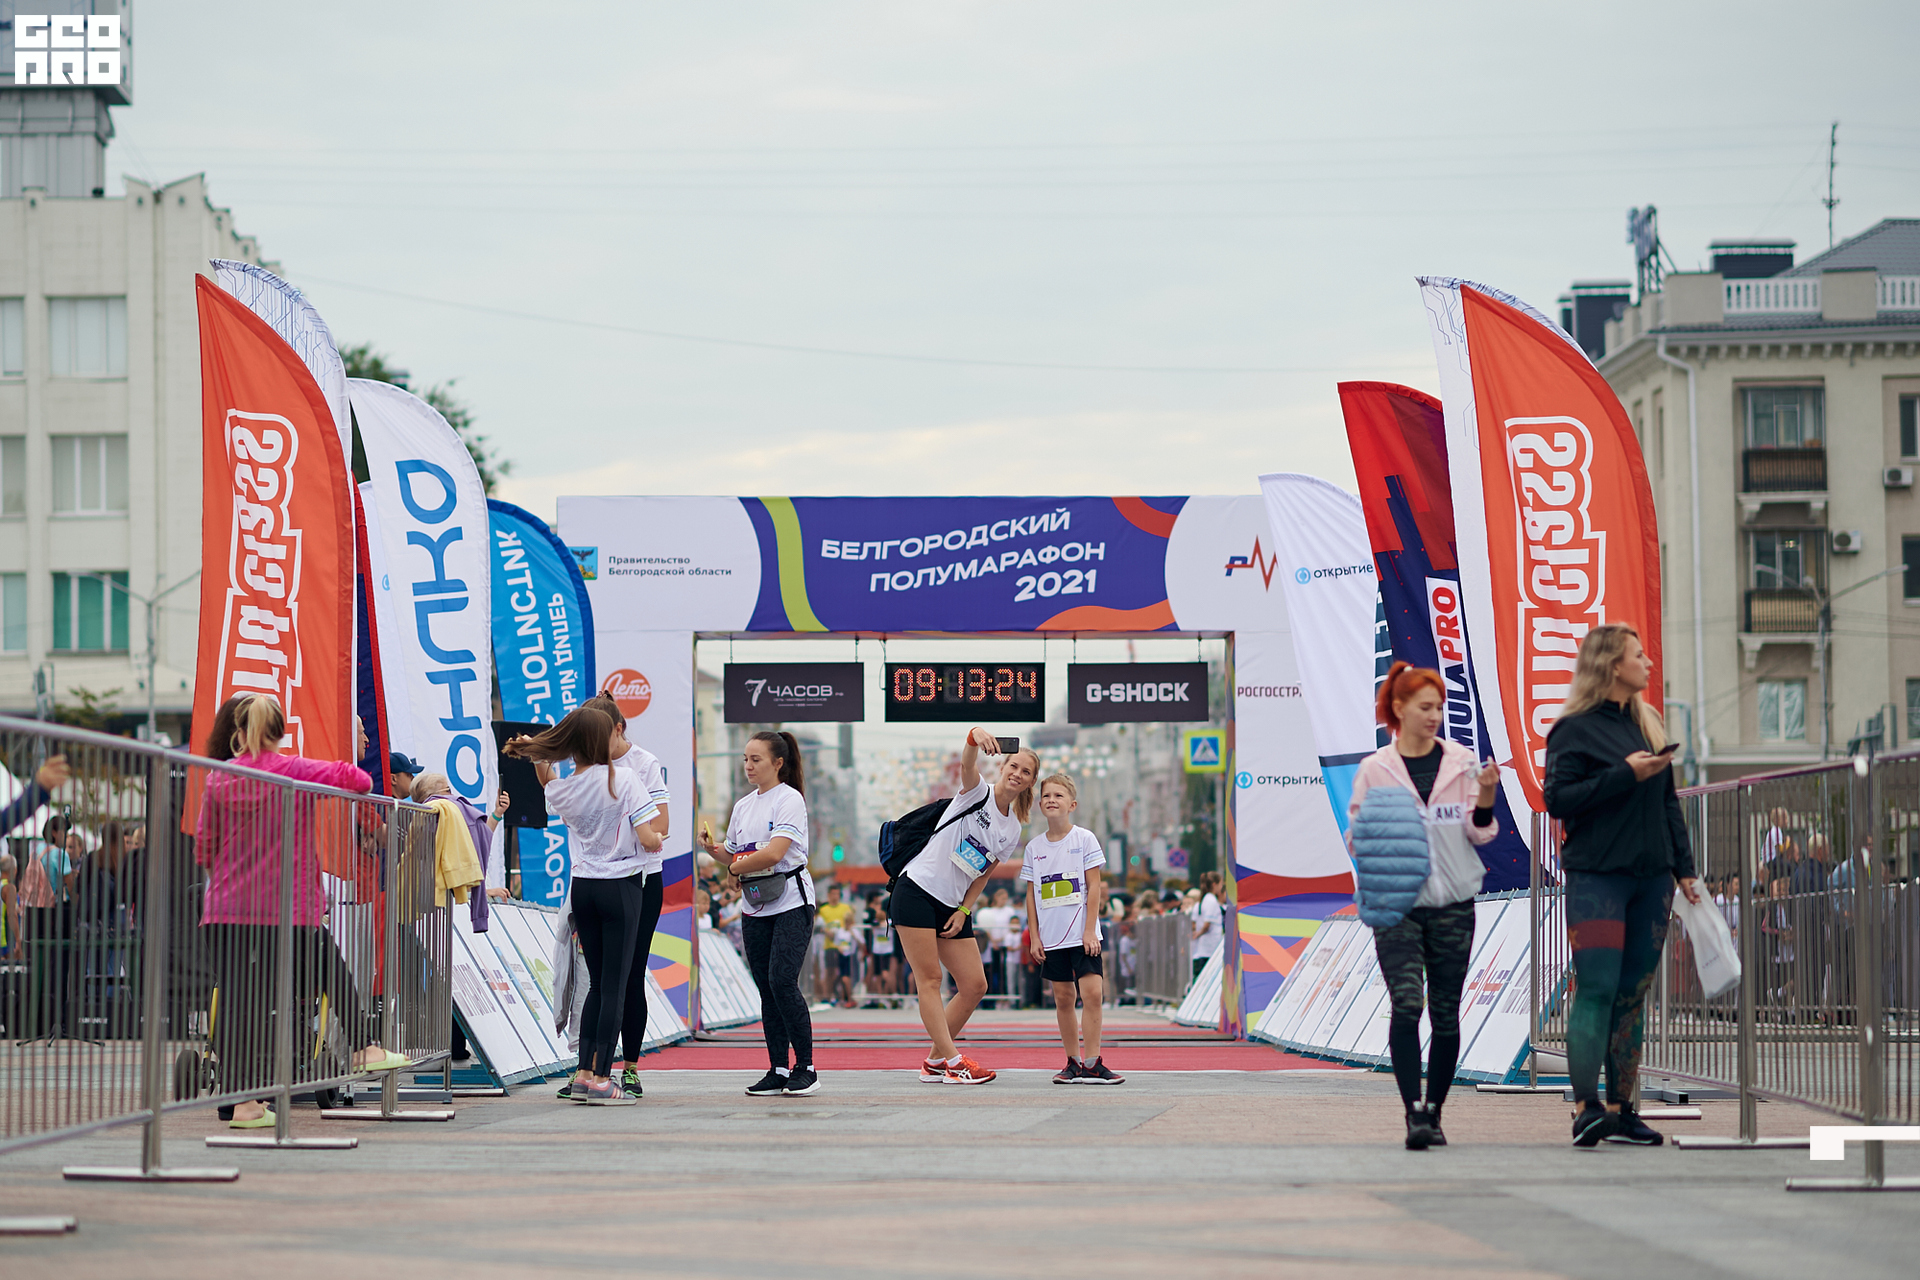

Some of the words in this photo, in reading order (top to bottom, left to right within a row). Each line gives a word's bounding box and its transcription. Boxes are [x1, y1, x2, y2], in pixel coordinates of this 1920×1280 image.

[821, 507, 1071, 561] БЕЛГОРОДСКИЙ
[608, 556, 691, 566] Правительство
[869, 542, 1106, 592] ПОЛУМАРАФОН
[608, 566, 685, 577] Белгородской
[688, 567, 732, 576] области
[1313, 563, 1374, 579] открытие
[1014, 568, 1097, 602] 2021
[767, 685, 833, 697] ЧАСОВ
[893, 668, 1037, 701] 09:13:24
[1086, 682, 1190, 703] G-SHOCK
[1257, 775, 1325, 788] открытие
[961, 847, 985, 868] 1342
[1050, 882, 1056, 897] 1
